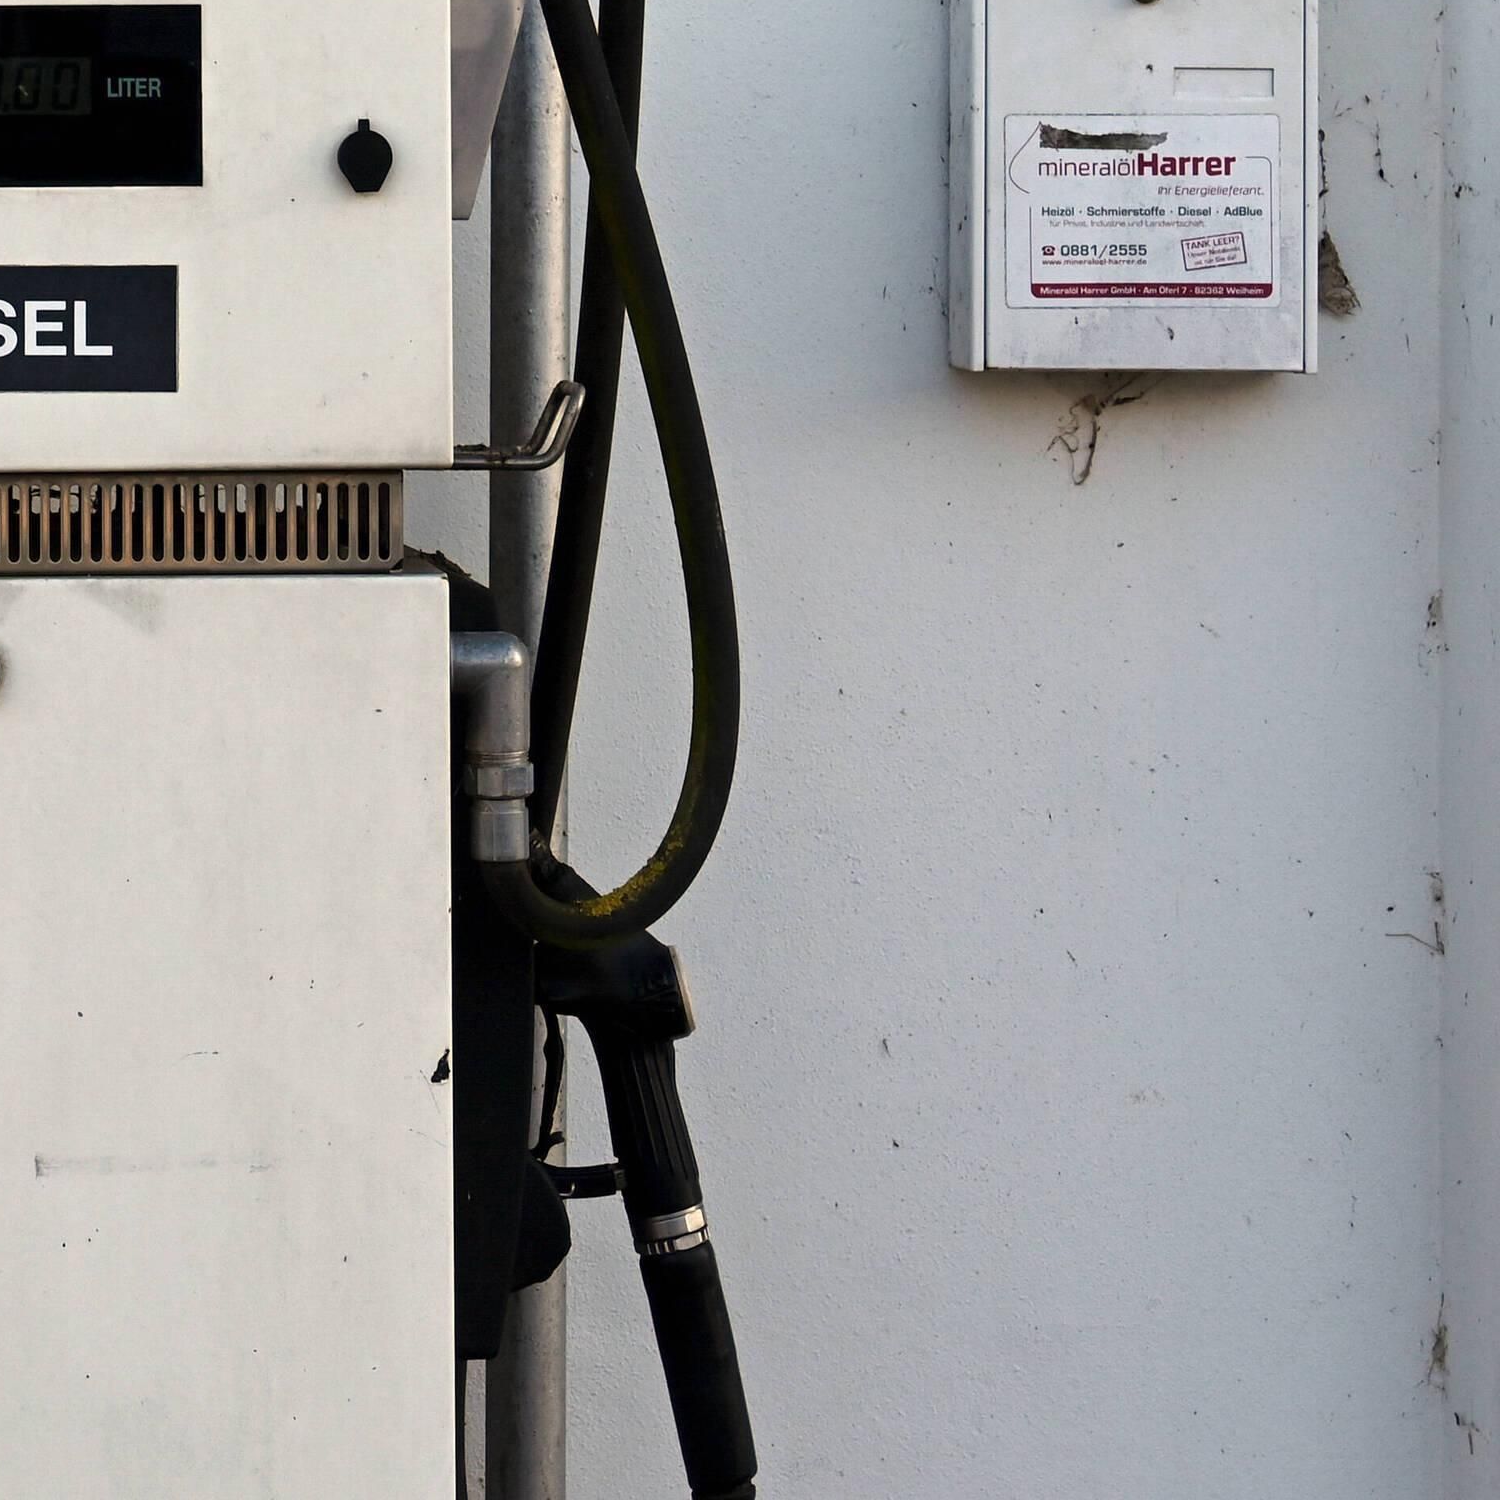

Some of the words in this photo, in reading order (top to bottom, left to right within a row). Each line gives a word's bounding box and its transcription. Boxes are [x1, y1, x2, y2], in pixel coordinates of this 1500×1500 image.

[107, 78, 162, 98] LITER
[1158, 186, 1172, 196] Ihr
[1175, 186, 1264, 197] Energielieferant.
[1041, 206, 1074, 217] Heizöl
[1086, 206, 1166, 217] Schmierstoffe
[1178, 206, 1212, 217] Diesel
[1224, 206, 1263, 217] AdBlue
[1185, 240, 1211, 250] TANK
[1212, 236, 1240, 246] LEER?
[1060, 244, 1148, 258] 0881/2555
[1040, 286, 1078, 294] Mineralöl
[1080, 286, 1108, 294] Harrer
[1110, 286, 1136, 294] GmbH
[1143, 286, 1158, 294] Am
[1182, 286, 1188, 294] 7
[1226, 286, 1264, 294] Weilheim
